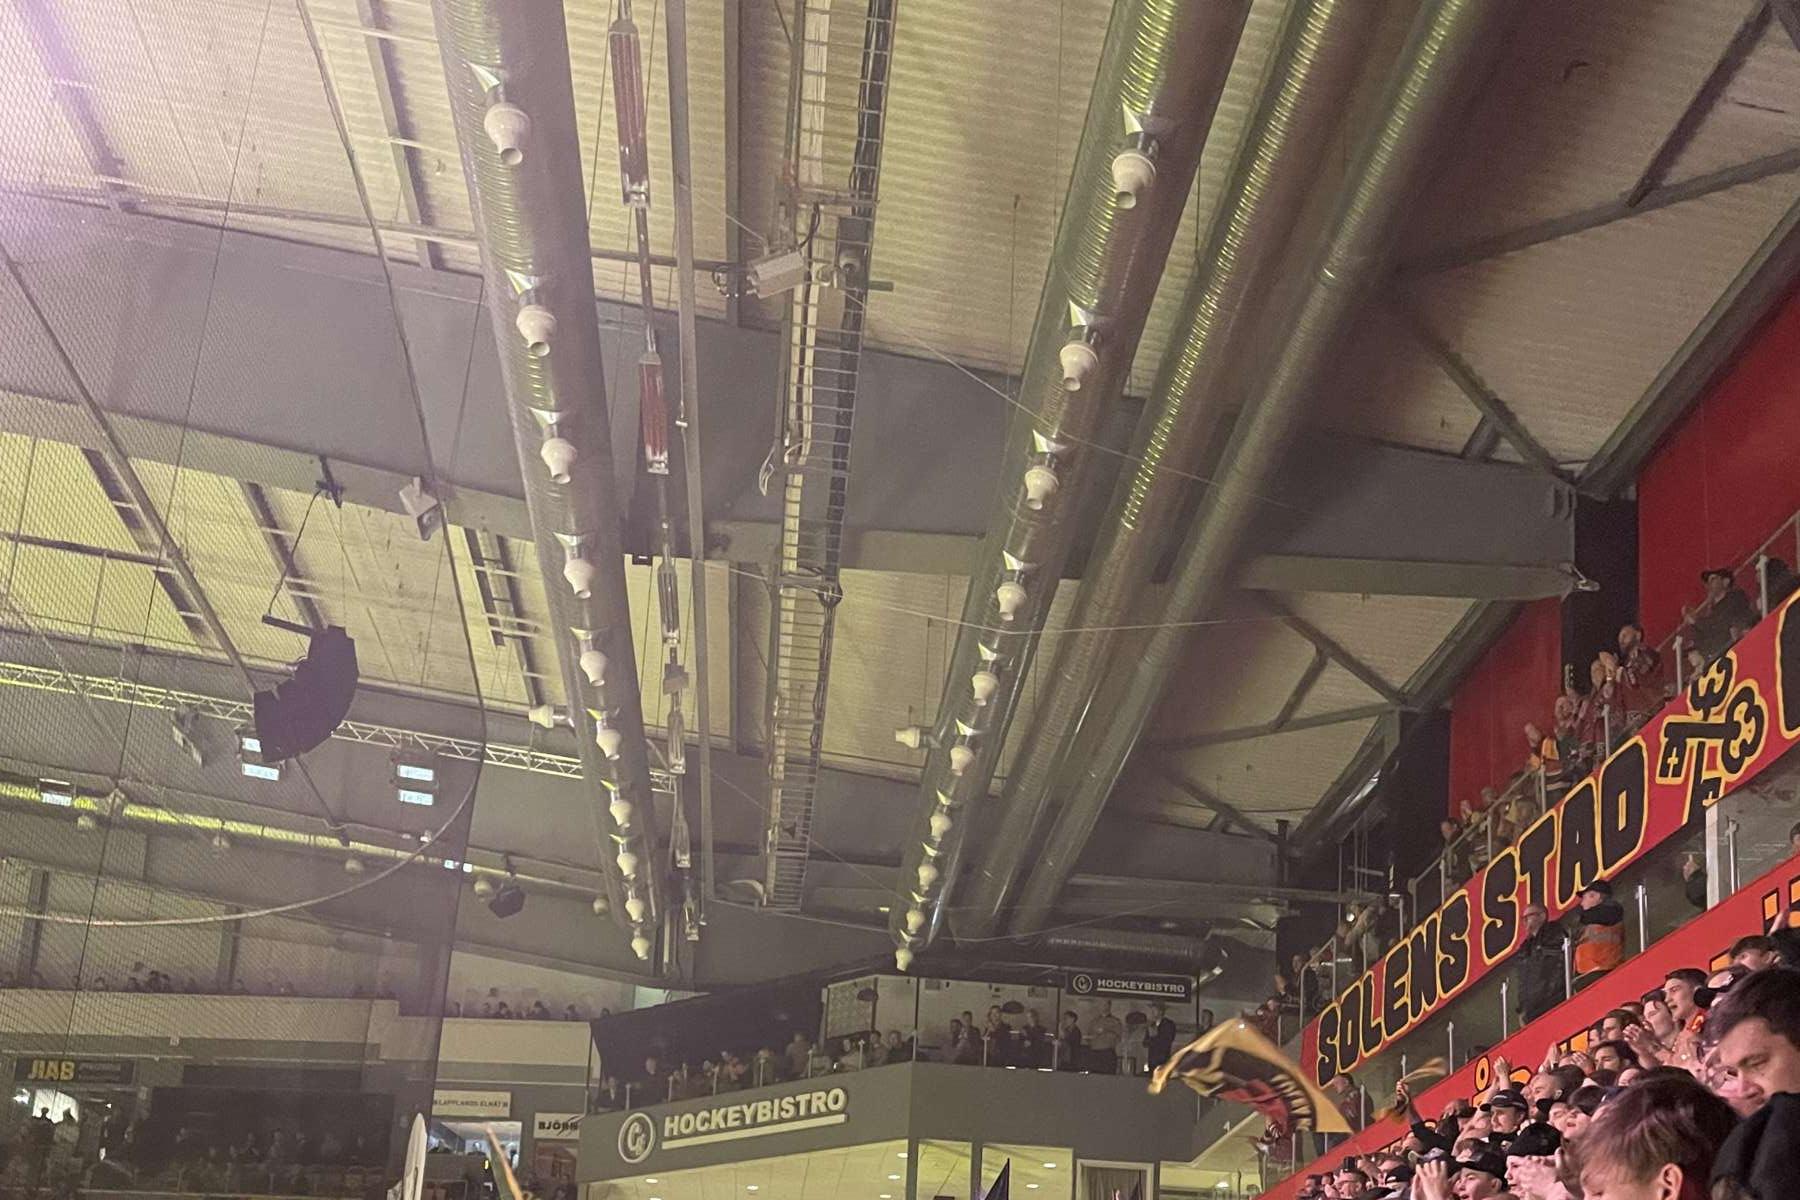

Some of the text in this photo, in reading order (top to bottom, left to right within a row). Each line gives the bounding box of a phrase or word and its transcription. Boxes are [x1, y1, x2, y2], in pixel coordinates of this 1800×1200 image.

[1316, 889, 1471, 1090] SOLENS
[1481, 735, 1649, 966] STAD
[1098, 978, 1185, 994] HOCKEYBISTRO
[664, 1087, 846, 1137] HOCKEYBISTRO
